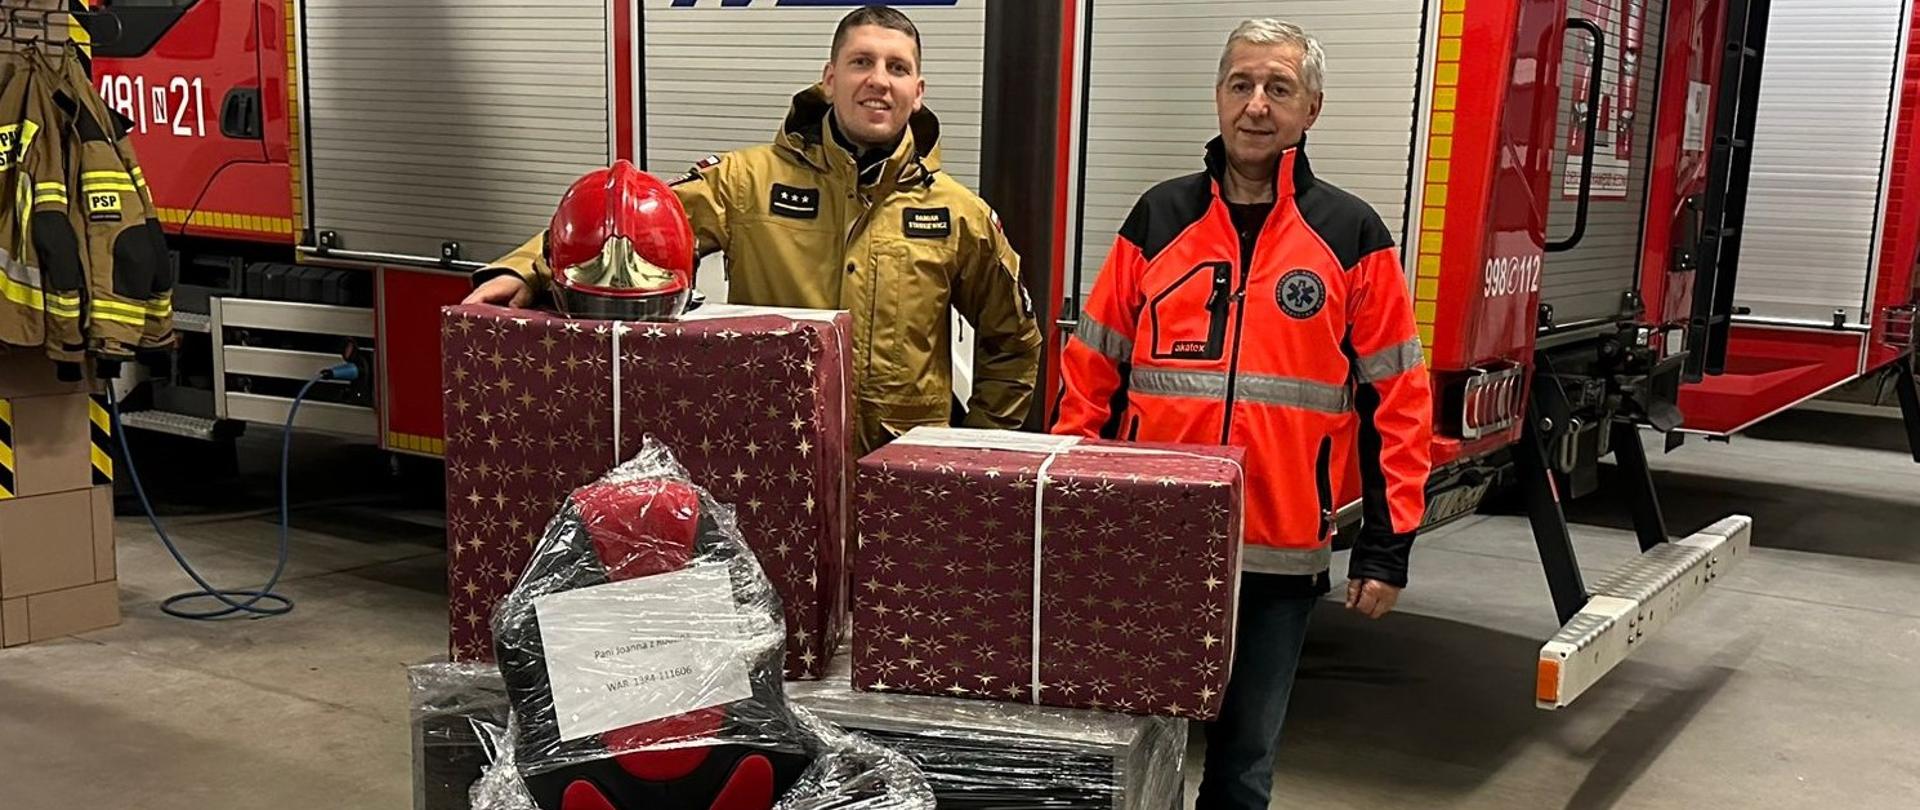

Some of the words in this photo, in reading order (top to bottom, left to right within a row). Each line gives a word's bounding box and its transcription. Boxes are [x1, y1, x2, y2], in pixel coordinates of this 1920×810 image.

[170, 76, 206, 137] 21
[92, 195, 117, 208] PSP
[1484, 257, 1507, 298] 998
[1520, 255, 1540, 293] 112
[594, 648, 614, 659] Pani
[616, 641, 648, 656] Joanna
